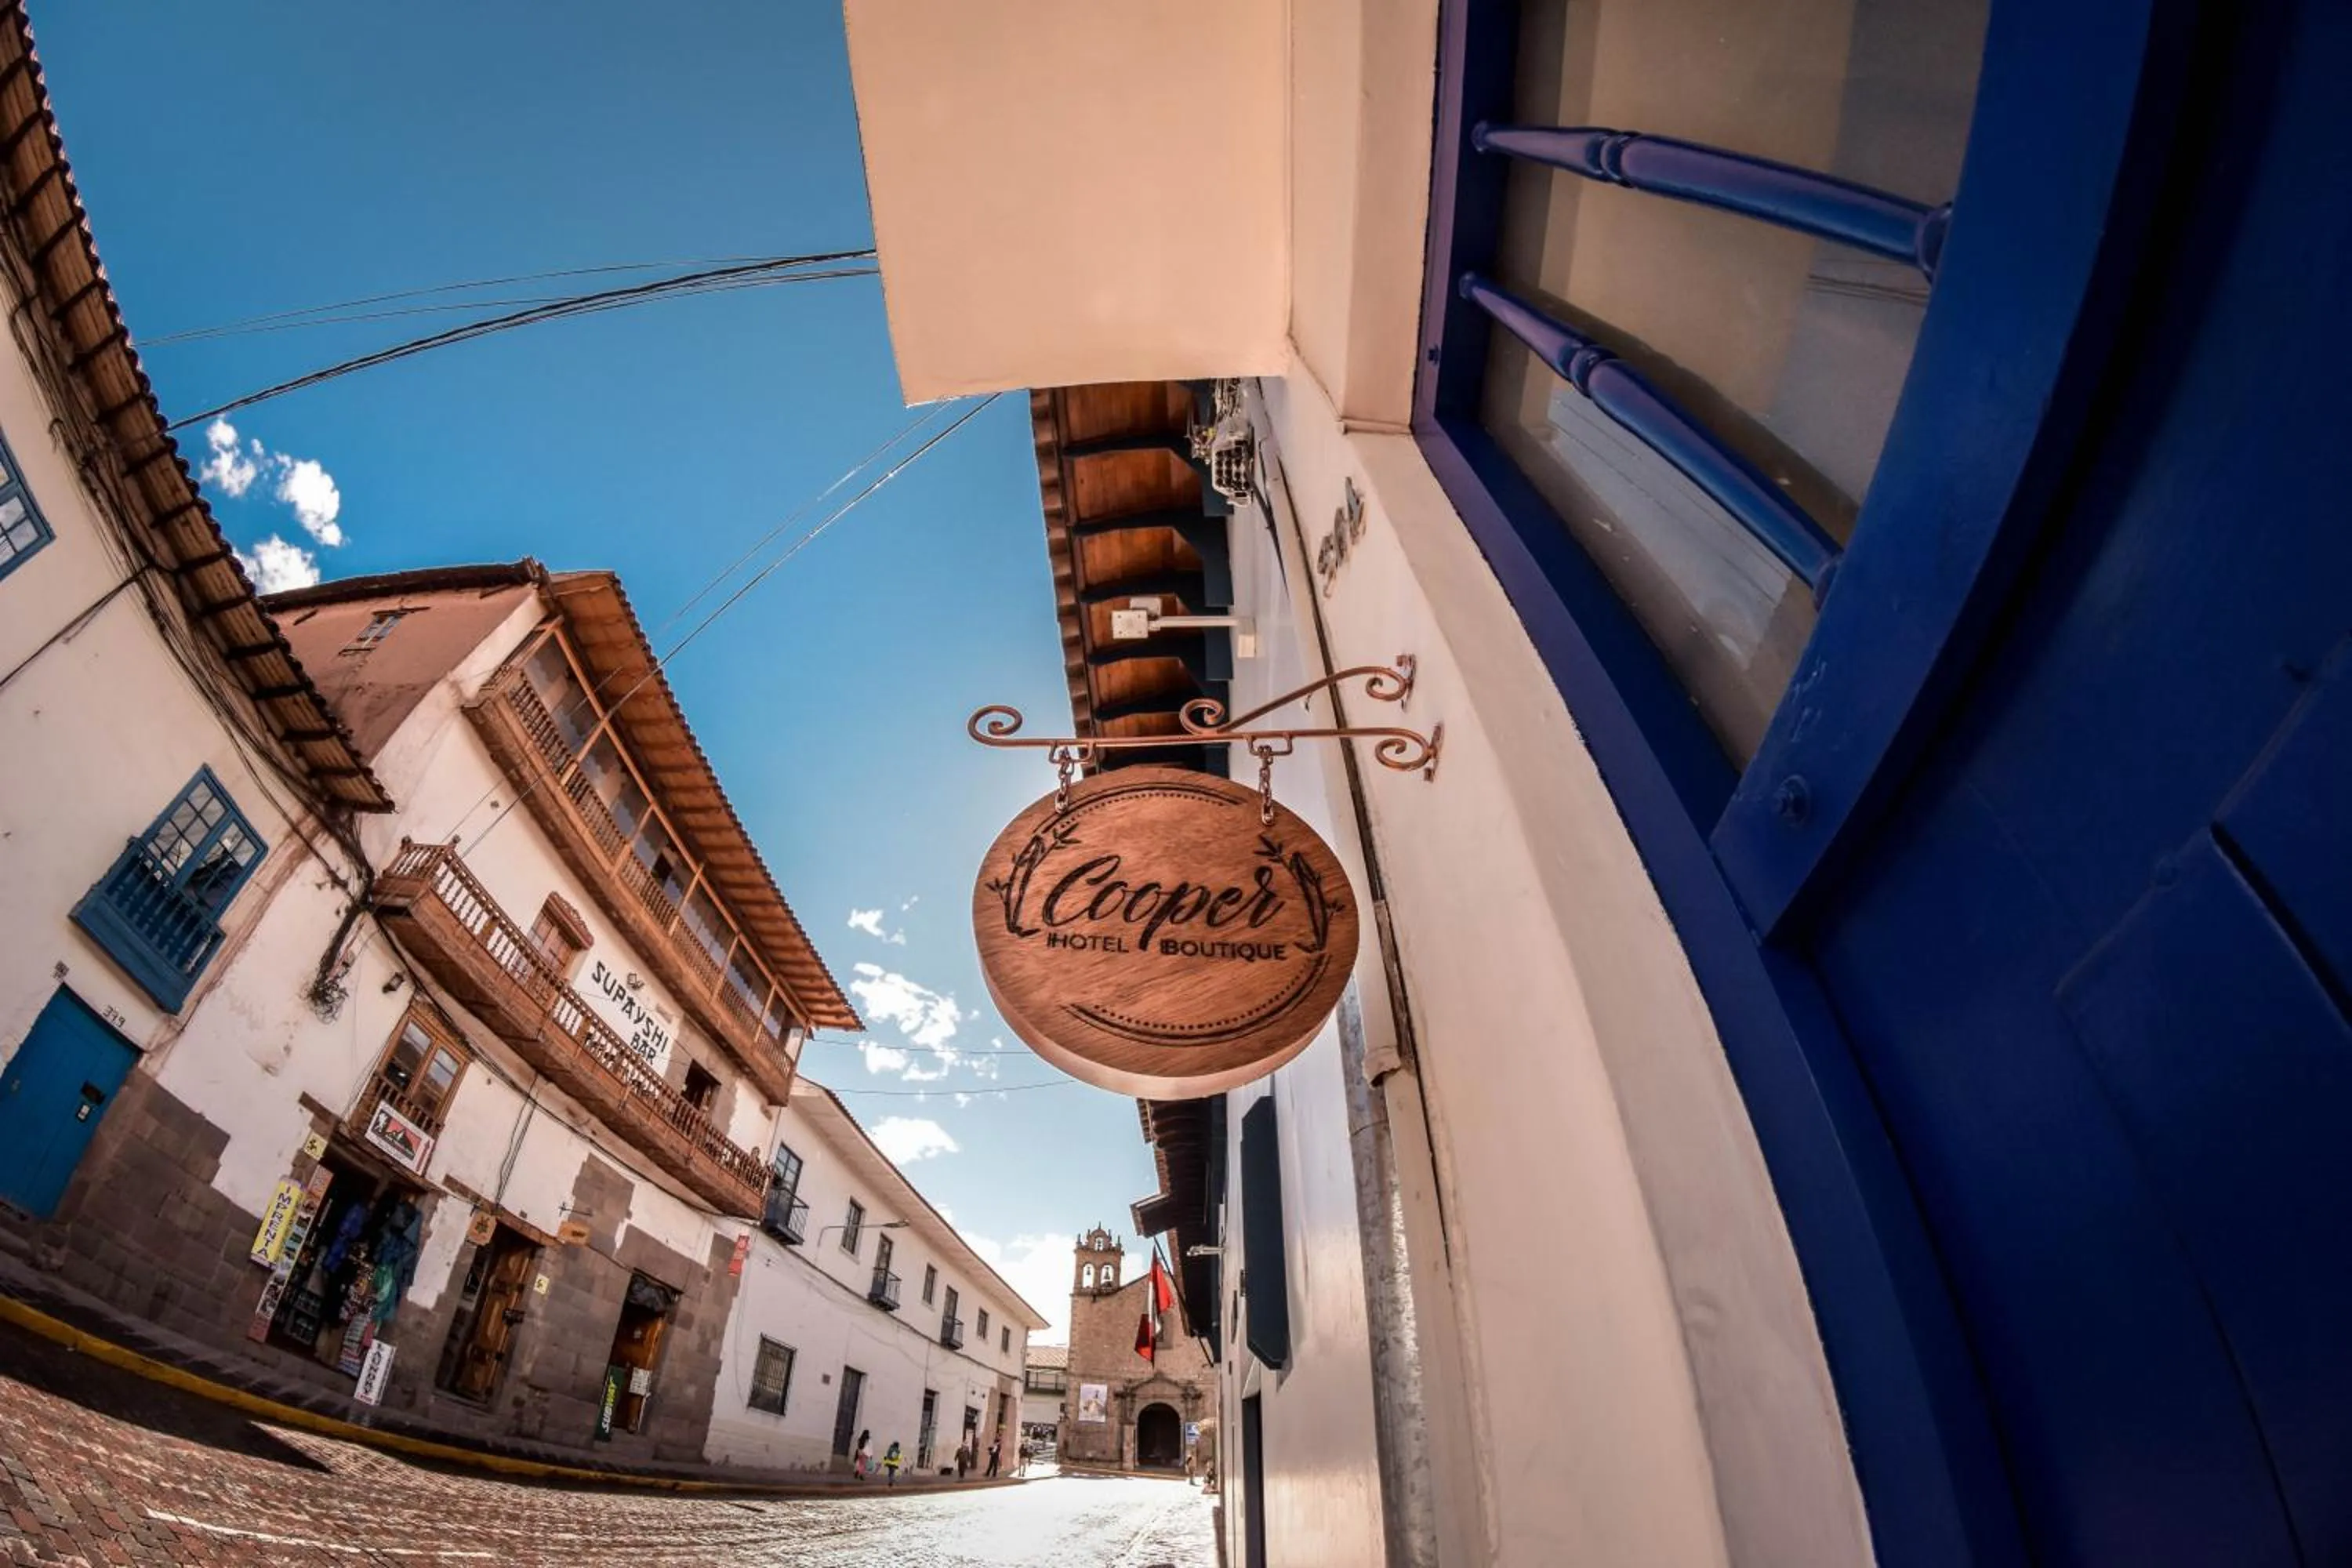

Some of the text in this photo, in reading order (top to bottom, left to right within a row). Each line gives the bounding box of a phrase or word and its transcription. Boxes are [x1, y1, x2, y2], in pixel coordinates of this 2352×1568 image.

[1042, 855, 1285, 951] Cooper
[1047, 932, 1288, 962] HOTEL BOUTIQUE
[592, 960, 669, 1053] SUPAYSHI
[630, 1032, 657, 1065] BAR
[257, 1185, 292, 1259] IMPRENTA
